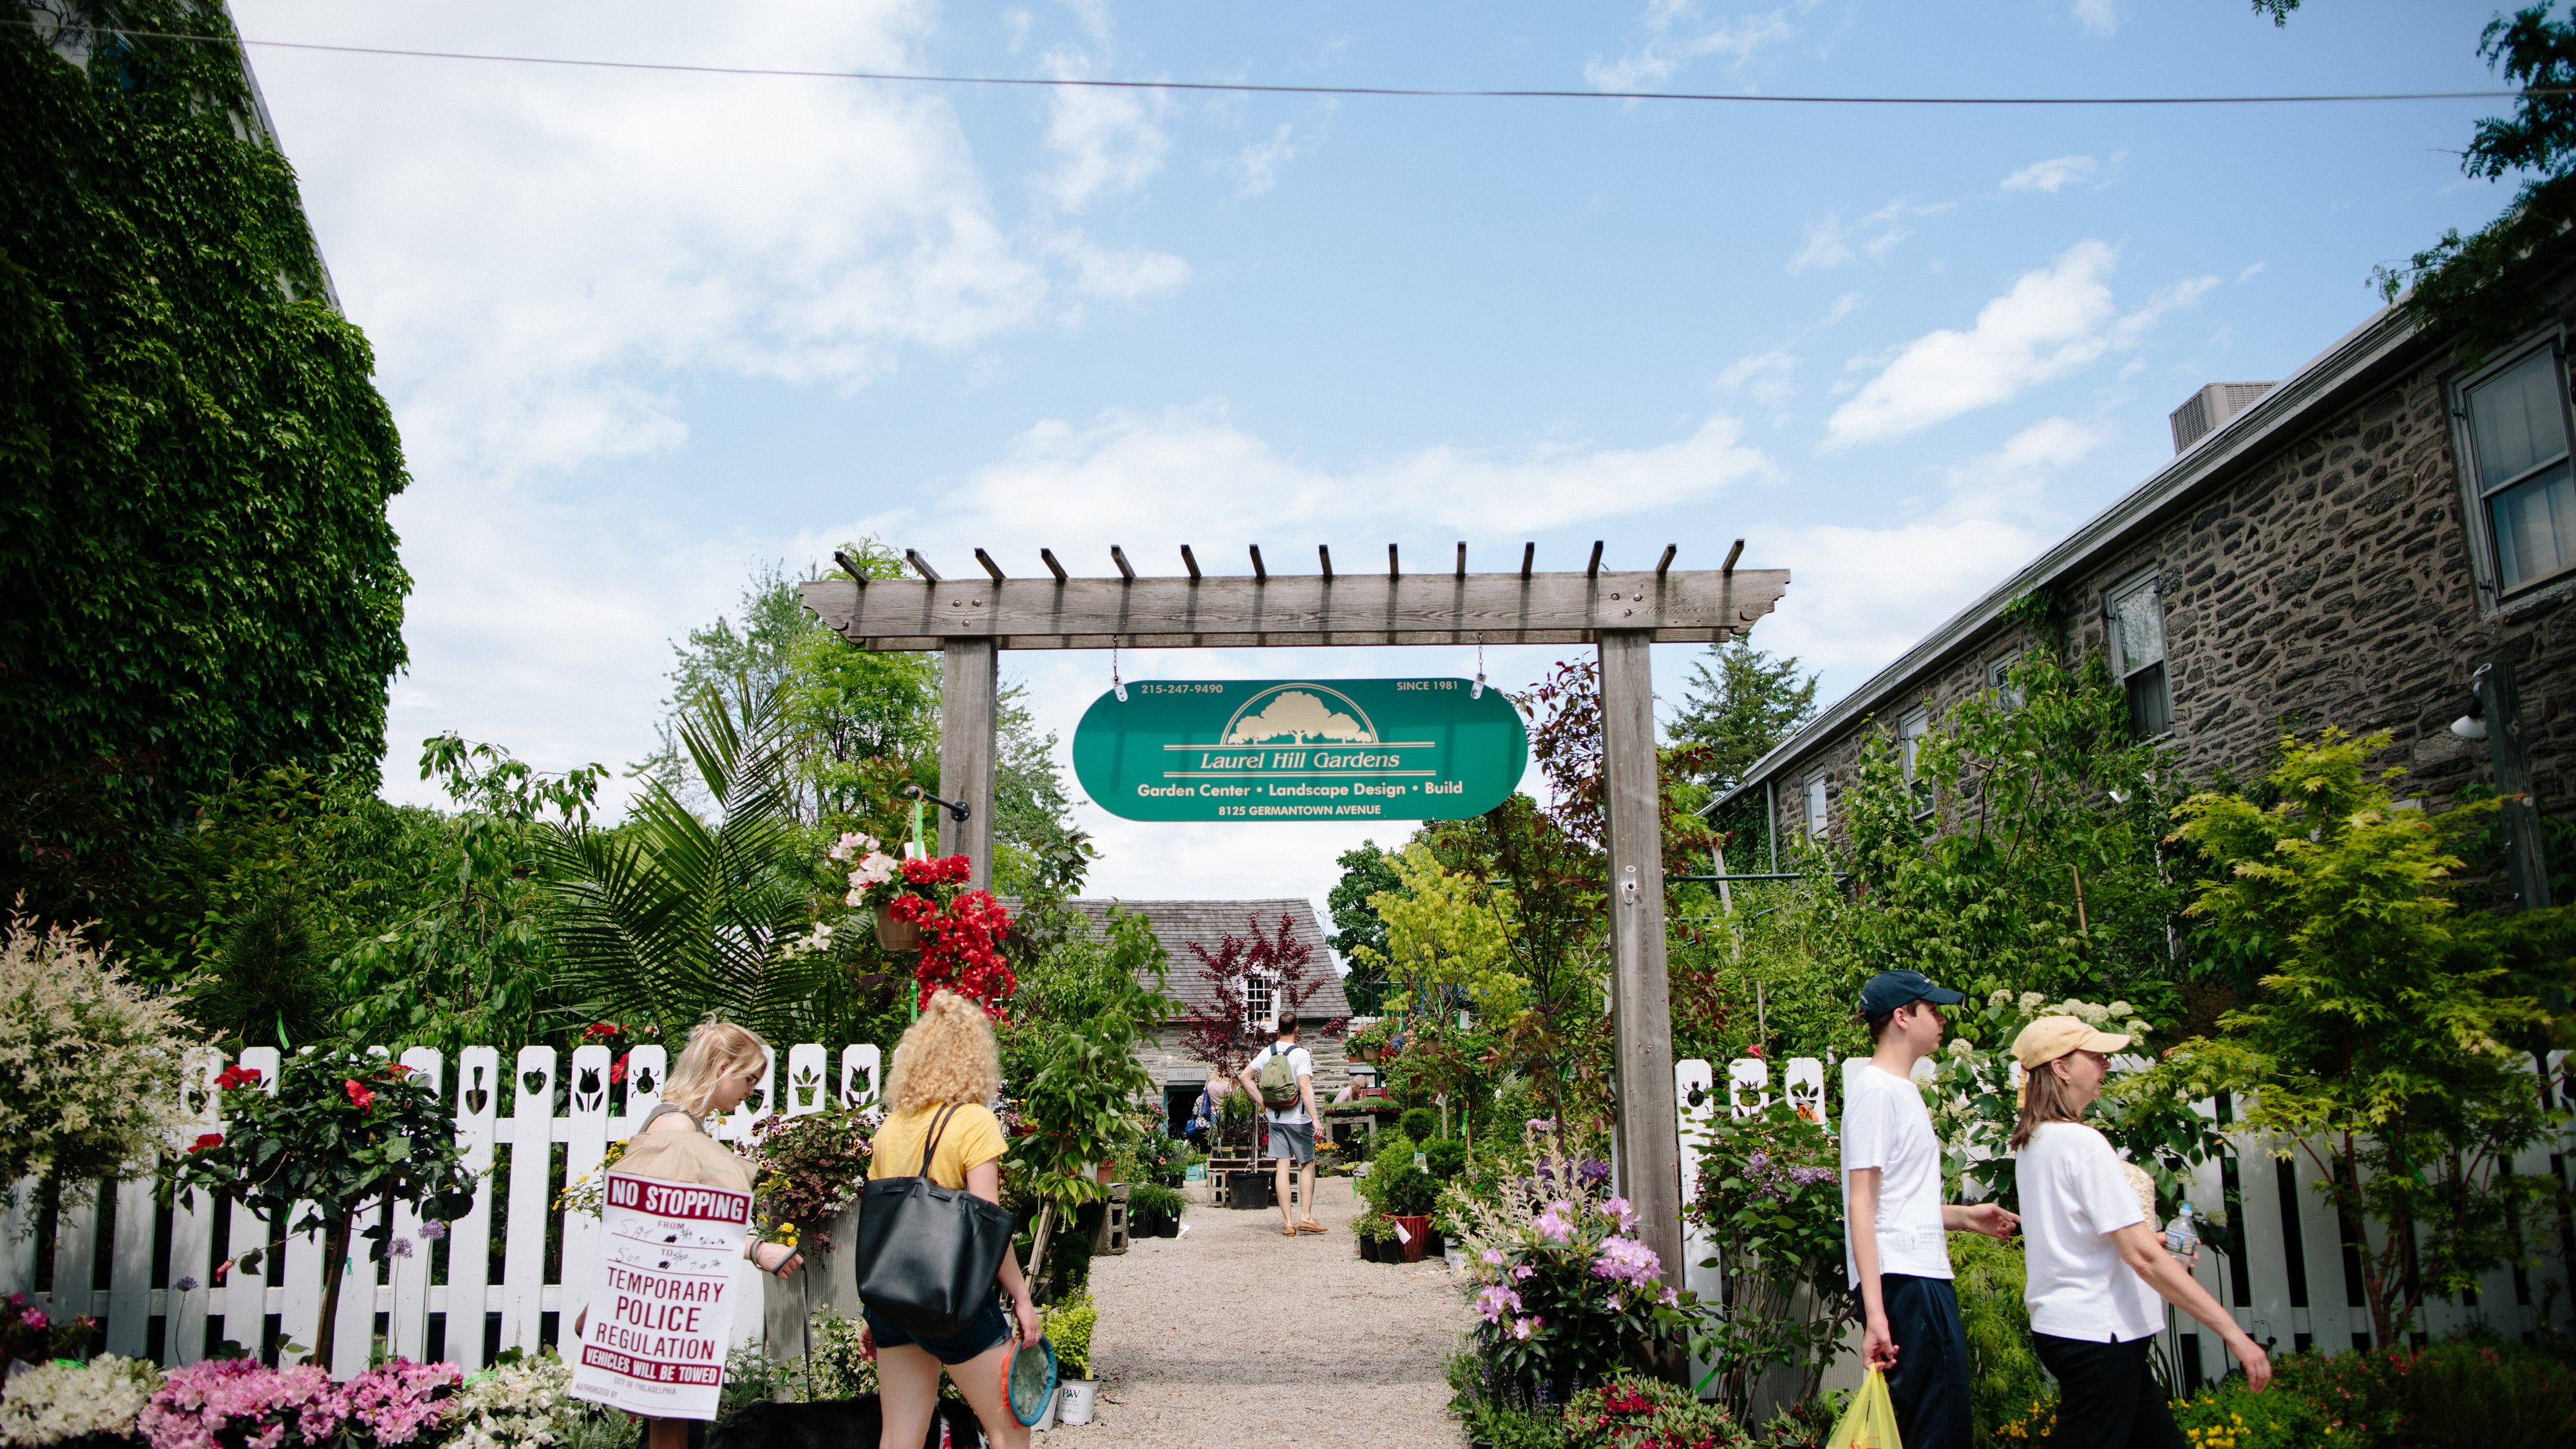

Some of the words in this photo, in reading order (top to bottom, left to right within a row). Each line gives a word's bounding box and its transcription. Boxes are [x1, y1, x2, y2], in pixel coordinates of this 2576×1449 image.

[1141, 684, 1224, 694] 215-247-9490
[1397, 681, 1429, 690] SINCE
[1434, 681, 1458, 690] 1981
[1200, 752, 1266, 769] Laurel
[1271, 752, 1307, 768] Hill
[1313, 752, 1400, 768] Gardens
[1137, 783, 1195, 797] Garden
[1199, 783, 1251, 797] Center
[1269, 782, 1349, 799] Landscape
[1354, 782, 1406, 798] Design
[1425, 780, 1463, 794] Build
[1218, 806, 1246, 816] 8125
[1249, 805, 1333, 816] GERMANTOWN
[1335, 804, 1381, 815] AVENUE
[1177, 1069, 1195, 1079] shop
[612, 1179, 639, 1206] NO
[645, 1186, 745, 1221] STOPPING
[658, 1220, 685, 1230] FROM
[661, 1248, 673, 1256] TO
[608, 1267, 725, 1303] TEMPORARY
[616, 1295, 702, 1333] POLICE
[596, 1322, 715, 1361] REGULATION
[585, 1347, 630, 1373] VEHICLES
[632, 1359, 657, 1380] WILL
[659, 1365, 676, 1381] BE
[679, 1366, 718, 1384] TOWED
[575, 1382, 609, 1397] AUTHORIZED
[611, 1390, 618, 1399] BY
[614, 1377, 626, 1386] CITY
[627, 1380, 634, 1388] OF
[636, 1381, 676, 1396] PHILADELPHIA
